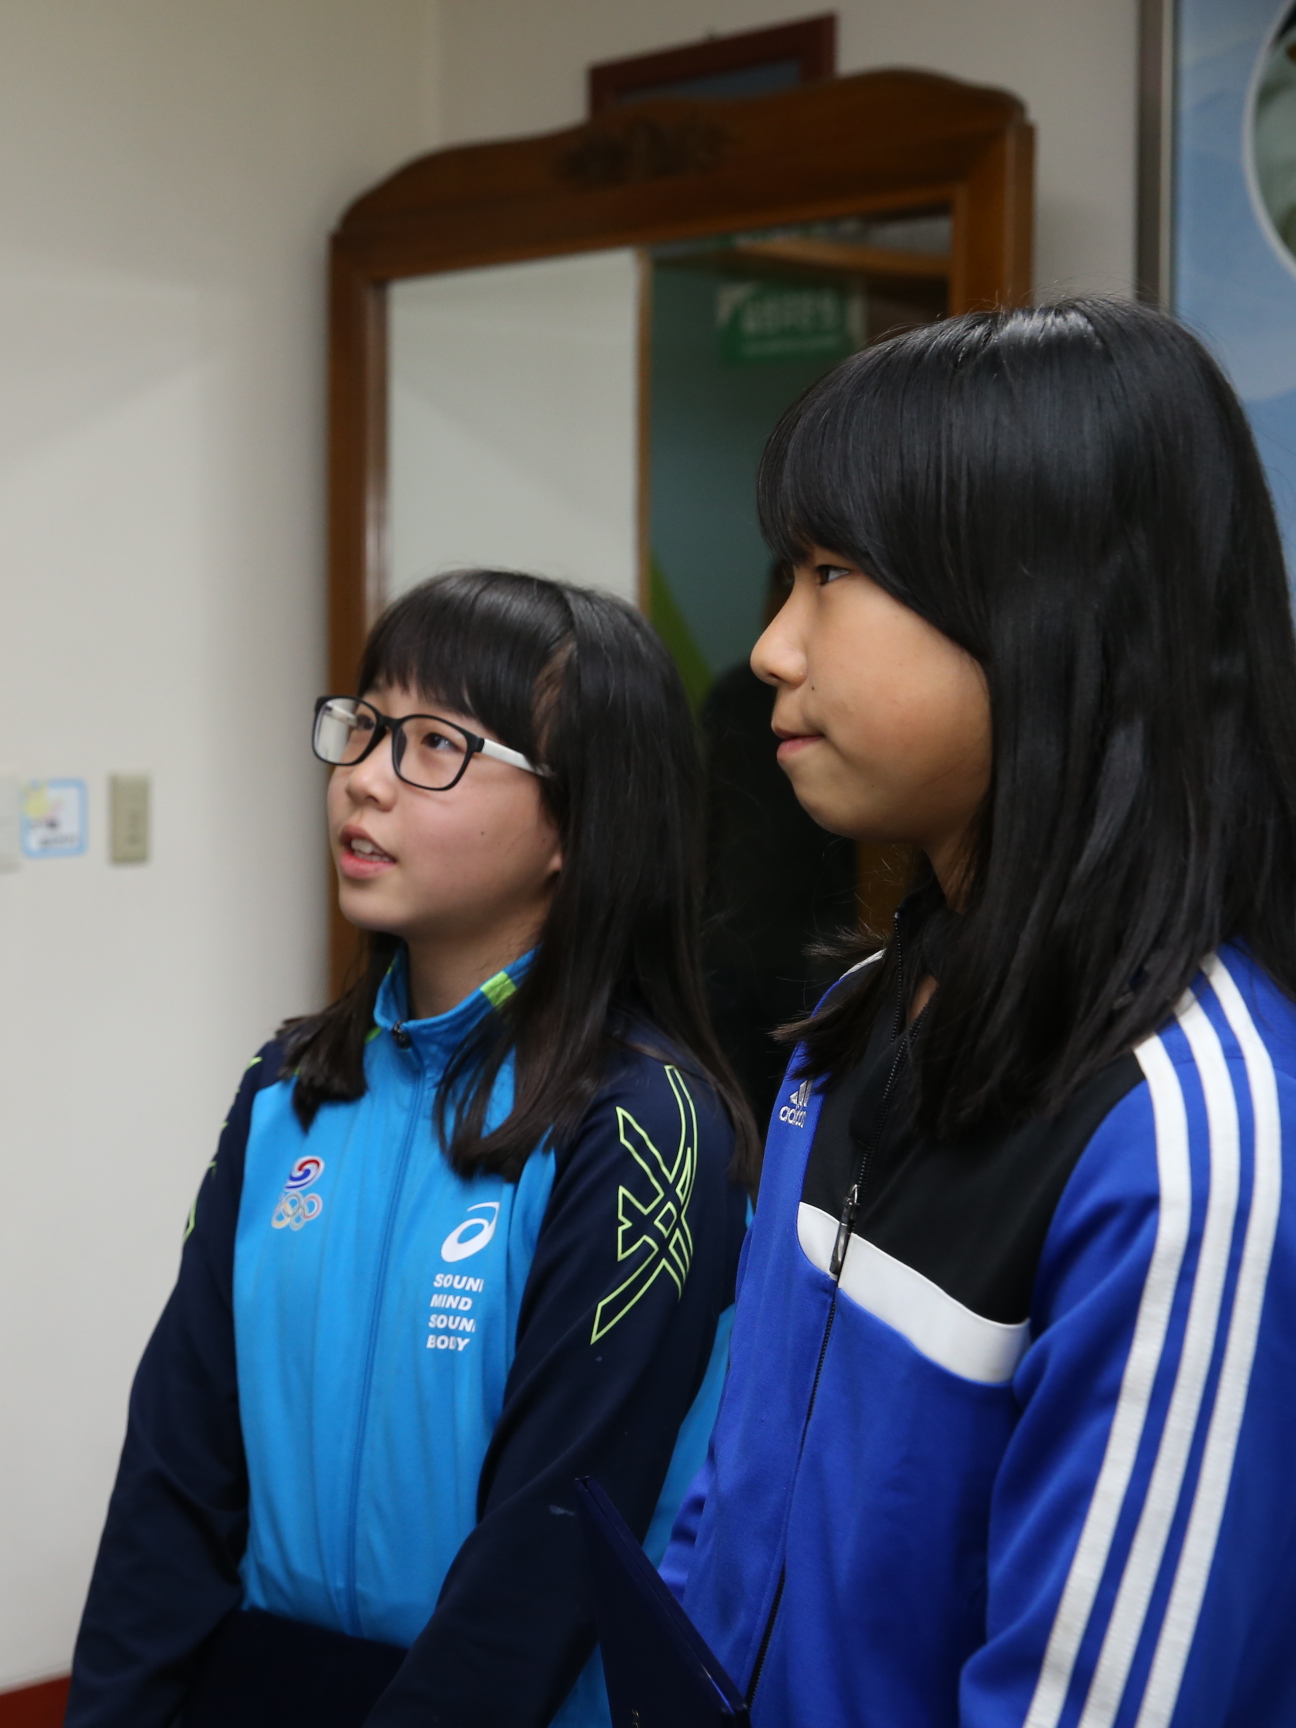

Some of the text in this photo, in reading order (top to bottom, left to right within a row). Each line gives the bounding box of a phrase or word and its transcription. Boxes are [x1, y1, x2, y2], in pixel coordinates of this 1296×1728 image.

[433, 1273, 484, 1293] SOUN
[429, 1294, 473, 1311] MIND
[428, 1314, 476, 1333] SOUN
